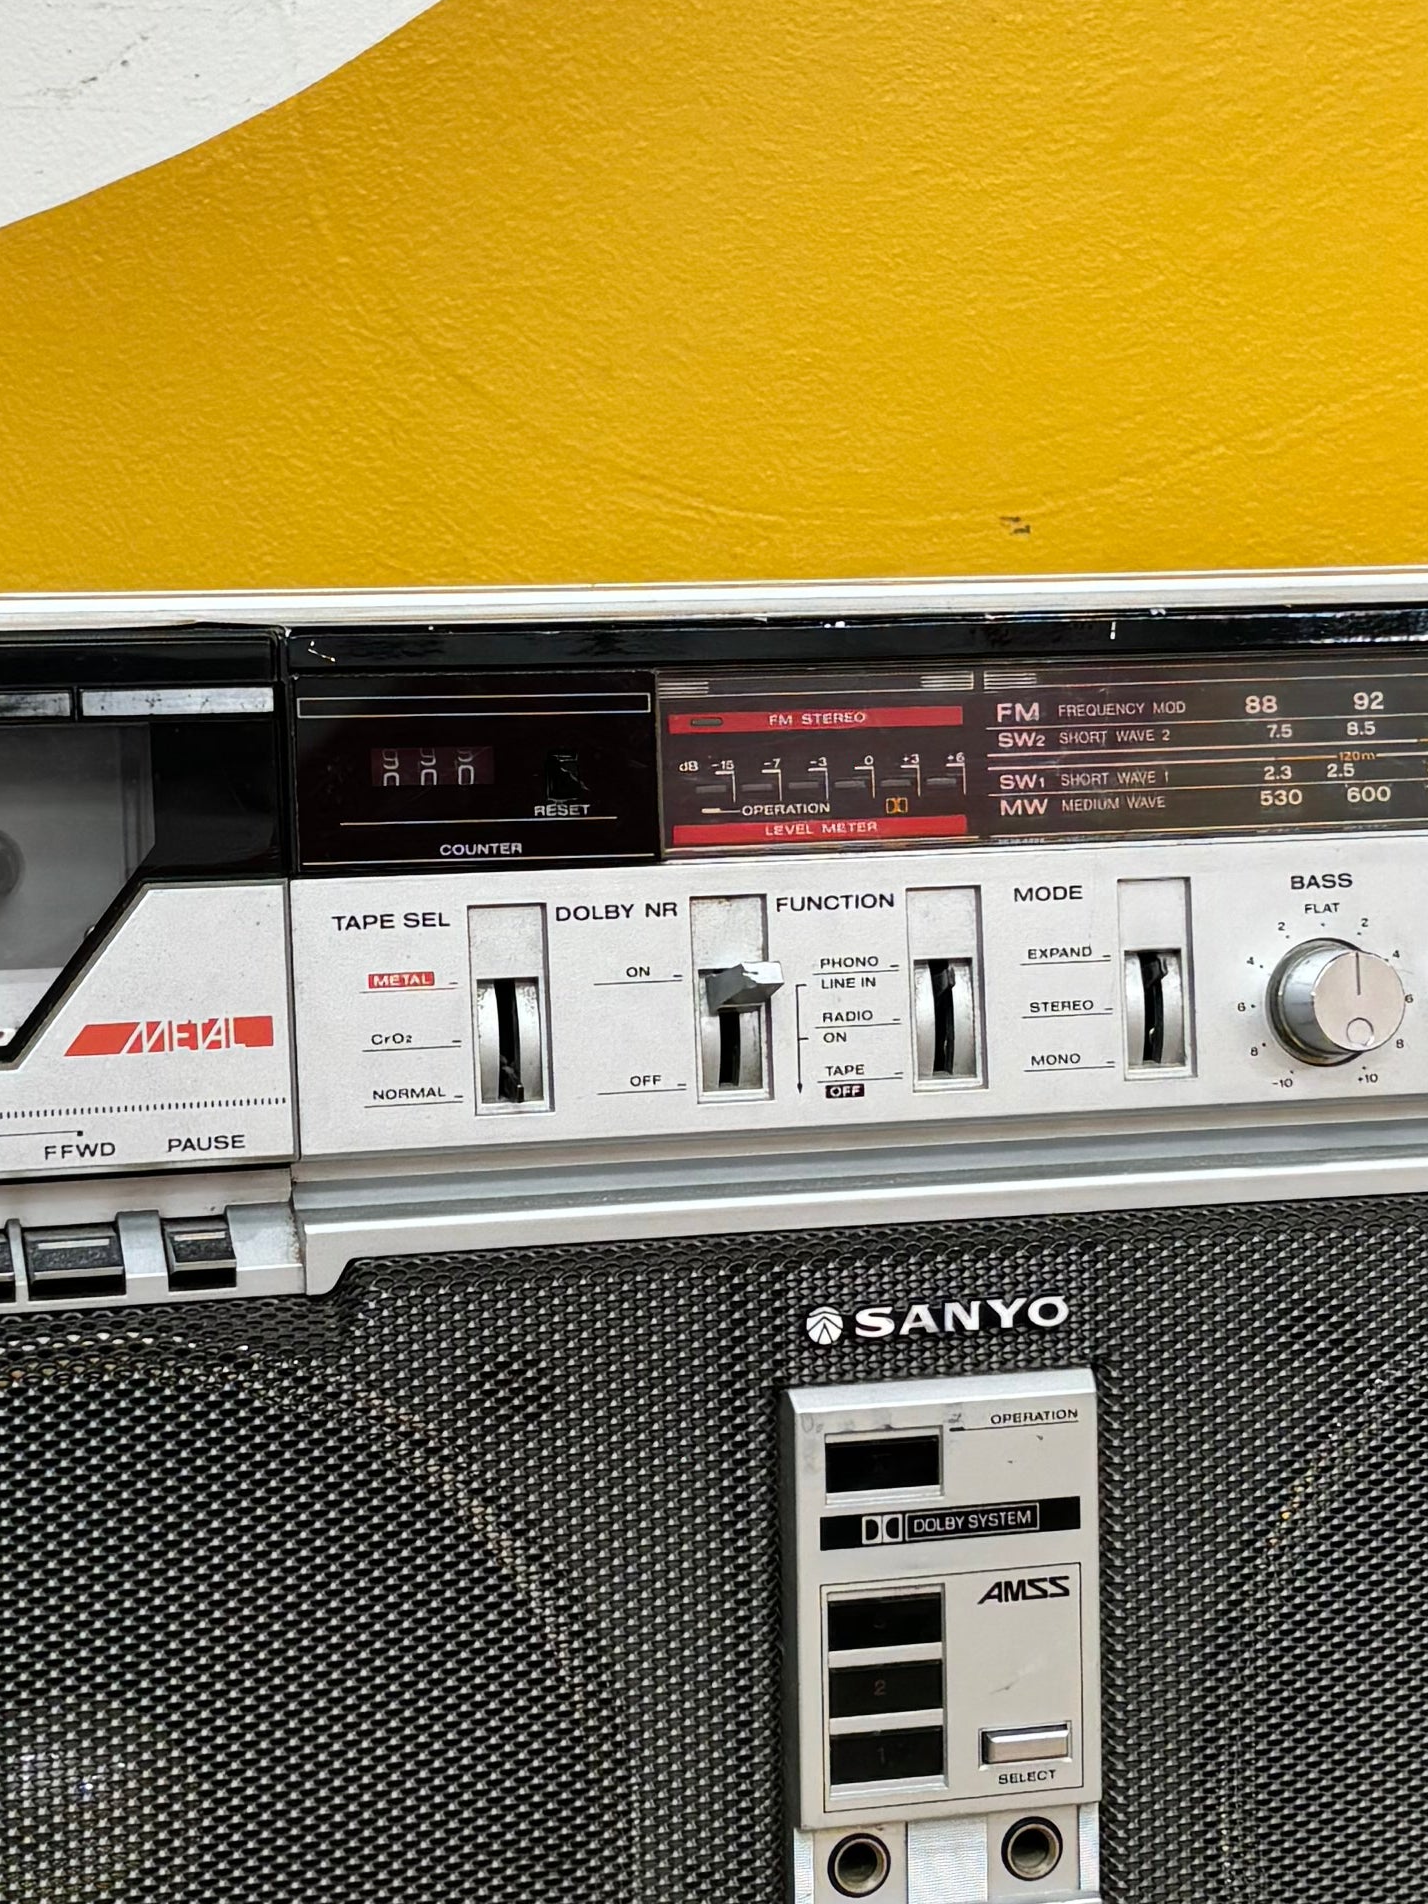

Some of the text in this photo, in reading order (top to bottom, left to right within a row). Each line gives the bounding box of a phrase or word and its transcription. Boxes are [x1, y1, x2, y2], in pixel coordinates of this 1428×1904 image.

[996, 702, 1040, 723] FM
[1058, 702, 1145, 717] FREQUENCY
[1152, 701, 1186, 714] MOD
[1245, 695, 1278, 714] 88
[1353, 691, 1384, 710] 92
[769, 711, 867, 726] FM STEREO
[1059, 730, 1107, 745] SHORT
[1116, 729, 1156, 742] WAVE
[1162, 729, 1171, 741] 2
[1267, 724, 1292, 738] 7.5
[1347, 721, 1376, 736] 8.5
[1338, 751, 1376, 761] 120m
[679, 760, 698, 773] dB
[1061, 772, 1109, 787] SHORT
[1117, 770, 1157, 785] WAVE
[1264, 766, 1291, 780] 2.3
[1327, 764, 1354, 778] 2.5
[1000, 798, 1048, 816] MW
[1061, 798, 1119, 812] MEDIUM
[1127, 796, 1166, 809] WAVE
[1260, 789, 1302, 806] 530
[1346, 786, 1391, 803] 600
[534, 804, 590, 817] RESET
[741, 802, 831, 816] OPERATION
[765, 821, 878, 836] LEVEL METER
[439, 842, 522, 856] COUNTER
[1290, 873, 1353, 890] BASS
[1014, 885, 1083, 902] MODE
[776, 893, 895, 913] FUNCTION
[1304, 902, 1340, 915] FLAT
[556, 903, 677, 922] DOLBY NR
[332, 912, 450, 931] TAPE SEL
[1277, 922, 1285, 931] 2
[1361, 918, 1369, 927] 2
[1028, 946, 1093, 960] EXPAND
[820, 956, 879, 969] PHONO
[627, 966, 650, 977] ON
[373, 973, 430, 986] METAL
[821, 978, 876, 989] LINE IN
[1029, 1000, 1094, 1013] STEREO
[1237, 1003, 1246, 1011] 6
[822, 1010, 873, 1023] RADIO
[122, 1018, 247, 1054] METAL
[823, 1033, 847, 1043] ON
[1396, 1039, 1404, 1048] 8
[1250, 1047, 1258, 1056] 8
[1031, 1053, 1081, 1066] MONO
[825, 1065, 865, 1077] TAPE
[630, 1075, 661, 1086] OFF
[1273, 1078, 1293, 1088] -10
[373, 1087, 446, 1100] NORMAL
[830, 1086, 860, 1097] OFF
[167, 1134, 246, 1153] PAUSE
[854, 1295, 1070, 1338] SANYO
[991, 1408, 1078, 1425] OPERATION
[914, 1509, 1032, 1533] DOLBY SYSTEM
[977, 1576, 1070, 1605] AMSS
[874, 1680, 886, 1696] 2
[998, 1769, 1057, 1785] SELECT
